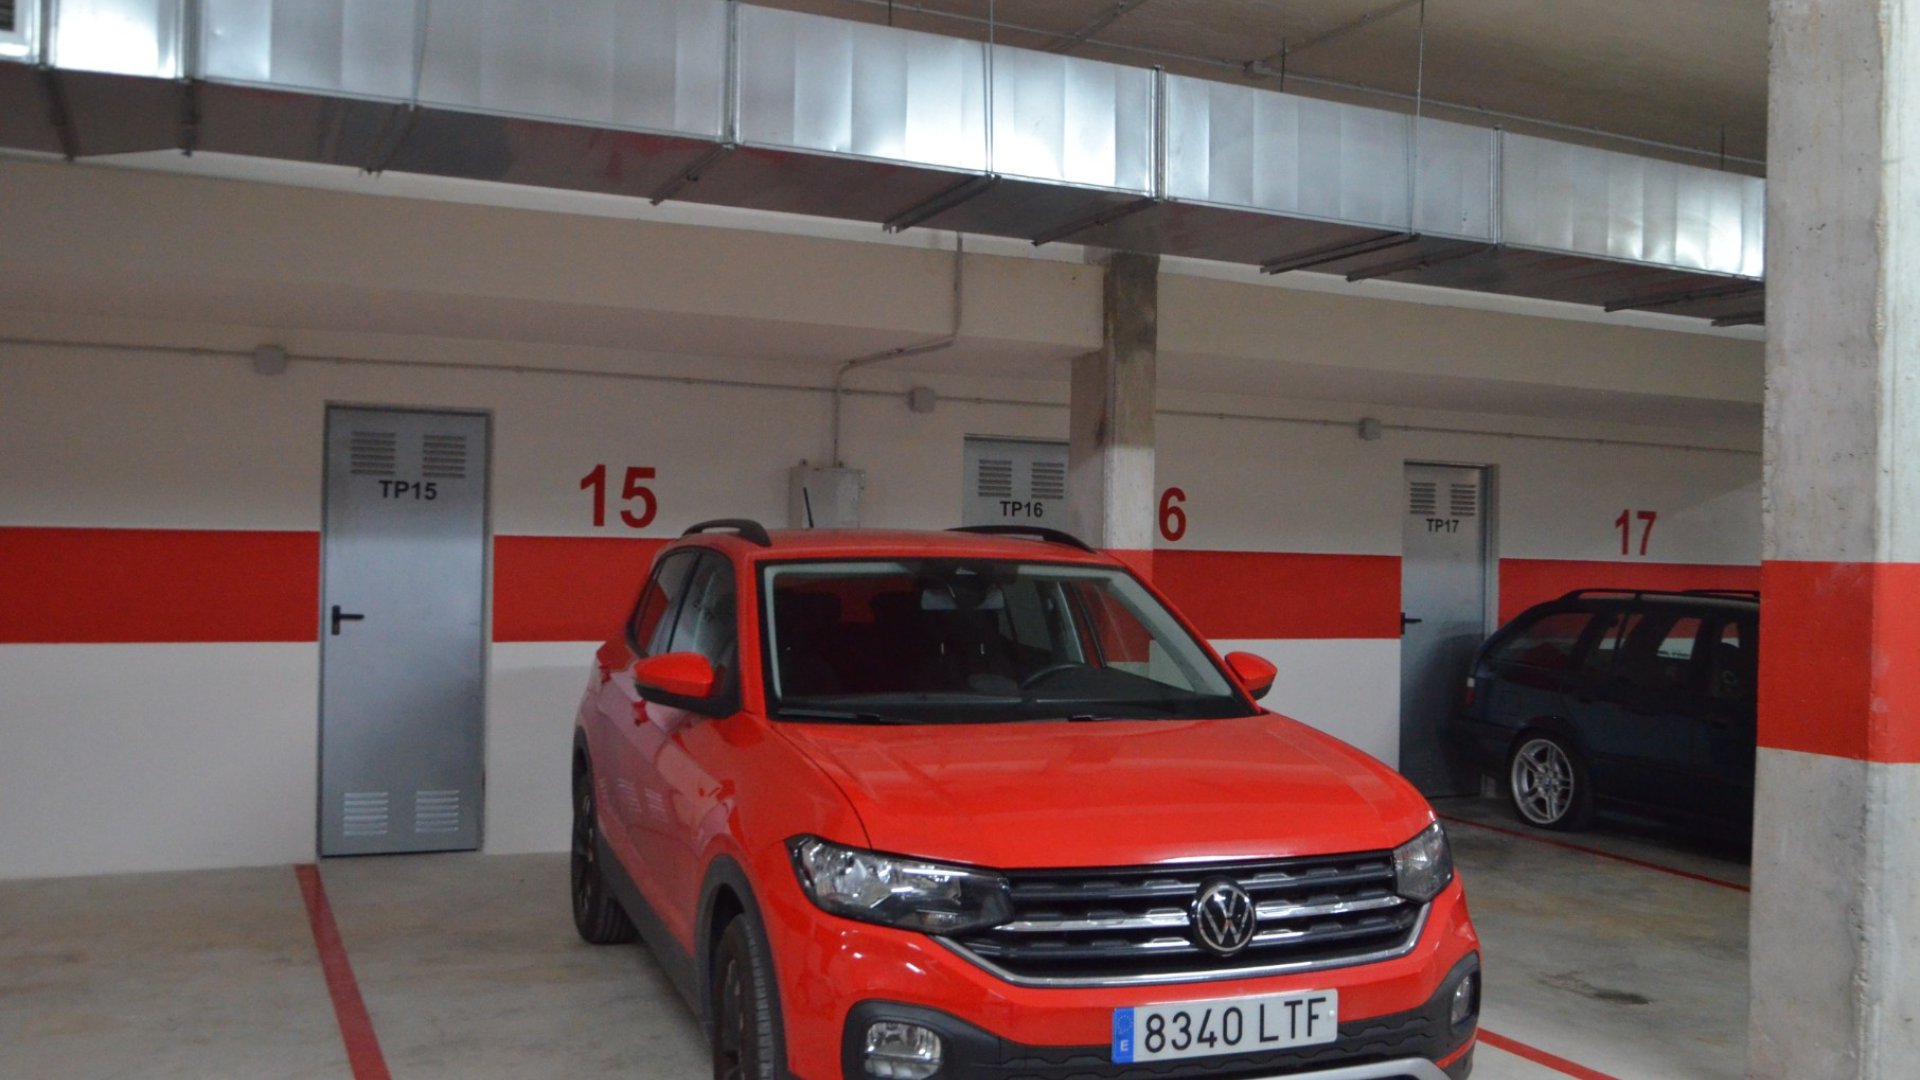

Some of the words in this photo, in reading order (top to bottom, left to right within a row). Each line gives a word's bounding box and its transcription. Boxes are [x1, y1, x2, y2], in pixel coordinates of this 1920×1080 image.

[378, 479, 438, 501] TP15
[579, 464, 658, 529] 15
[1000, 500, 1044, 519] TP16
[1426, 518, 1460, 534] TP17
[1614, 508, 1657, 556] 17
[1144, 1006, 1243, 1053] 8340
[1258, 997, 1327, 1043] LTF
[1120, 1040, 1129, 1052] E
